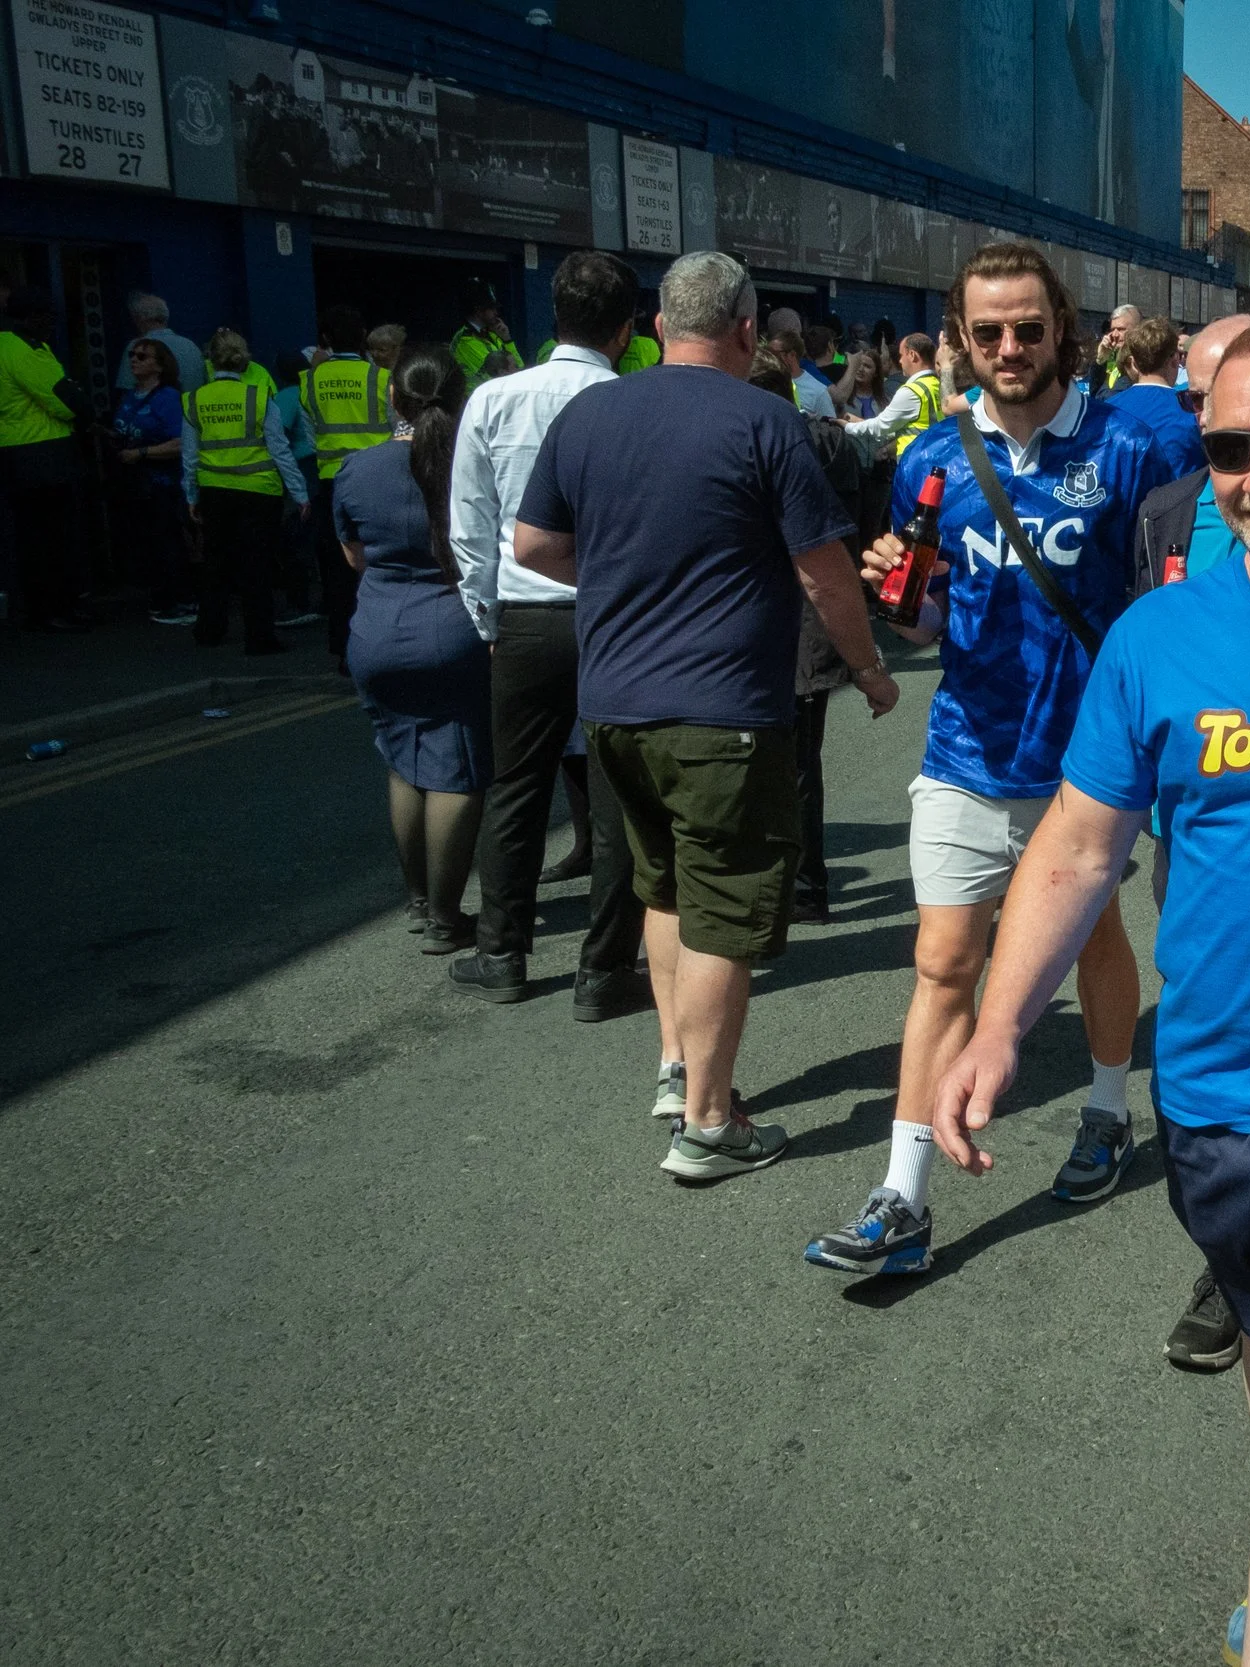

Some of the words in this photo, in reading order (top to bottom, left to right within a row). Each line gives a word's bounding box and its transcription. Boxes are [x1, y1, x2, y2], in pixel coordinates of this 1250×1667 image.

[49, 1, 95, 21] HOWARD
[97, 11, 144, 33] KENDALL
[28, 11, 80, 32] GWLADYS
[82, 23, 120, 41] STREET
[123, 33, 143, 47] END
[71, 35, 107, 53] UPPER
[35, 51, 102, 79] TICKETS
[107, 65, 144, 87] ONLY
[41, 84, 92, 109] SEATS
[97, 94, 146, 117] 82-159
[49, 119, 145, 150] TURNSTILES
[58, 143, 86, 169] 28
[117, 152, 142, 177] 27
[632, 174, 657, 190] TICKETS
[658, 180, 673, 193] ONLY
[637, 195, 656, 208] SEATS
[636, 215, 673, 232] TURNSTILES
[639, 230, 650, 245] 26
[661, 233, 672, 248] 25
[318, 380, 362, 389] EVERTON
[319, 391, 363, 401] STEWARD
[199, 403, 242, 413] EVERTON
[201, 414, 243, 424] STEWARD
